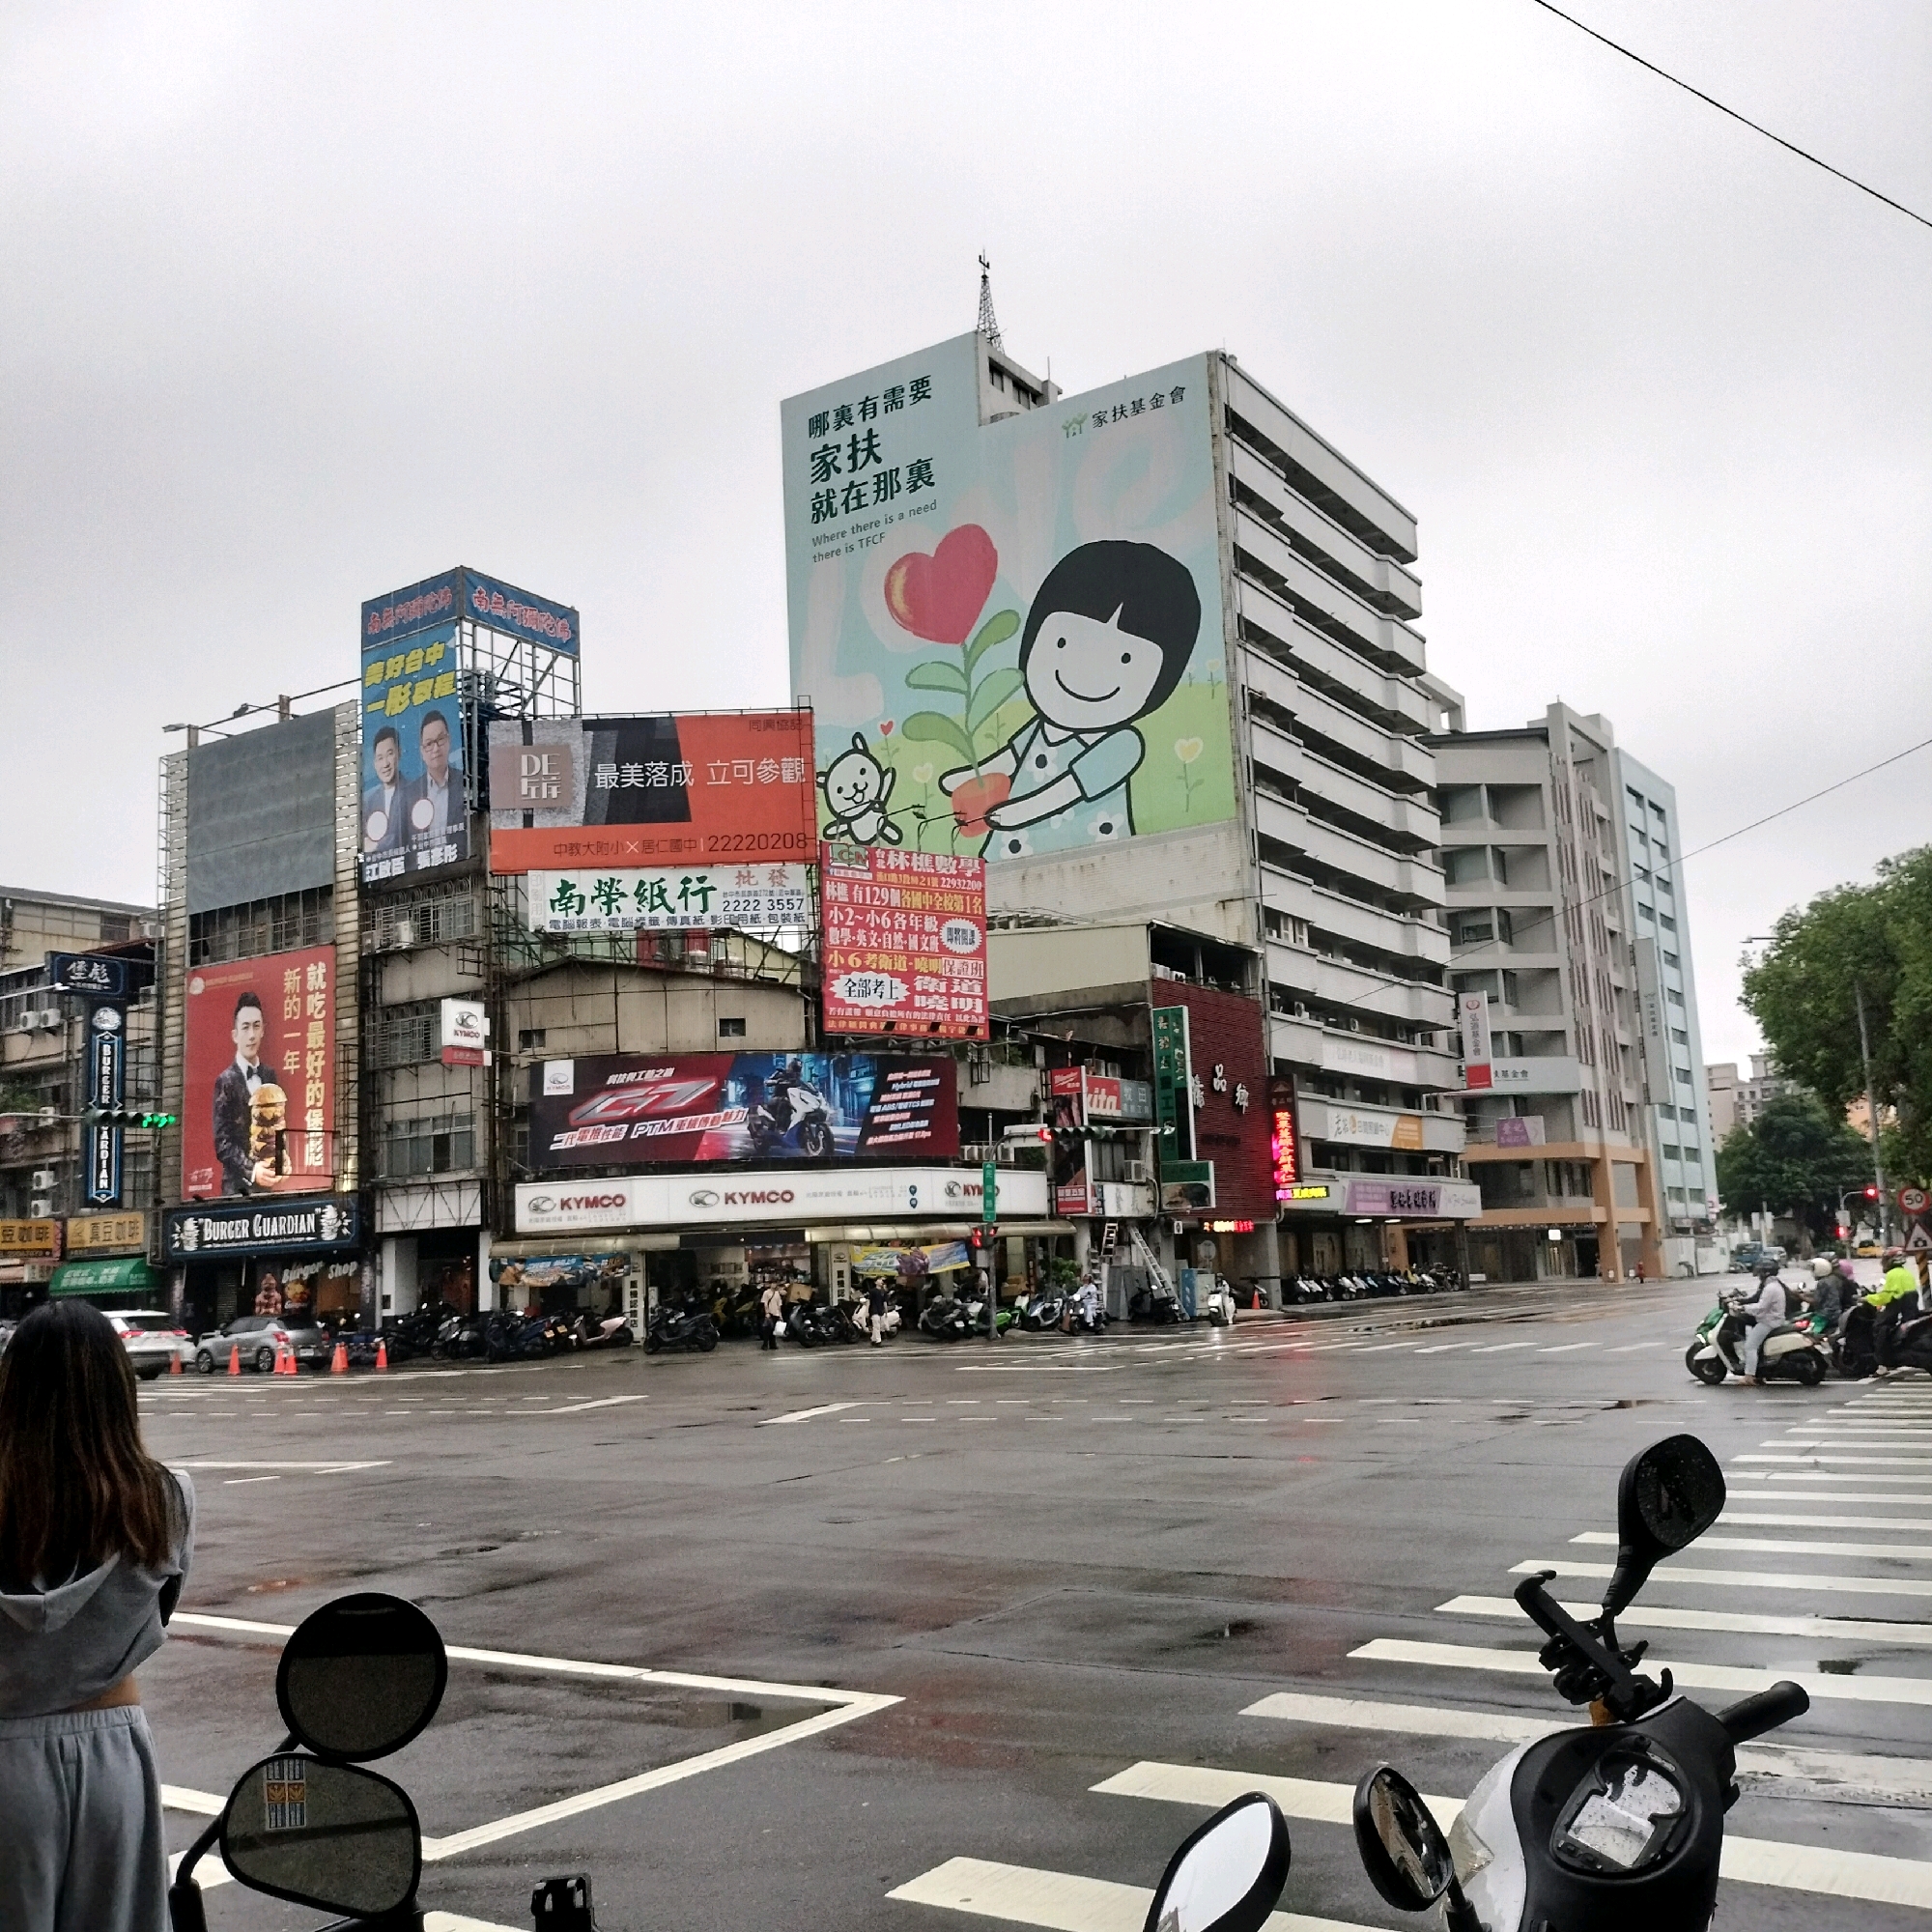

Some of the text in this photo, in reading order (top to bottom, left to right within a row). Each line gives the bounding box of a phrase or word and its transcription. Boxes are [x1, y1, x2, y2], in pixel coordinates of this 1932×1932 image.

[809, 375, 932, 440] 哪裏有需要
[1092, 385, 1187, 429] 家扶基金會
[810, 427, 883, 485] 家扶
[810, 457, 935, 525] 就在那裏
[811, 498, 938, 547] Where there is a need
[812, 532, 886, 563] there is TFCF
[472, 585, 572, 643] 南無阿彌陀佛
[595, 757, 806, 790] 最美落成 立可參觀
[707, 833, 808, 853] 22220208
[735, 869, 789, 888] 批發
[550, 875, 717, 918] 南榮紙行
[723, 898, 804, 912] 2222 3557
[843, 978, 899, 1001] 全部考上
[282, 967, 301, 1075] 新的一年
[560, 1193, 626, 1211] KYMCO
[724, 1189, 795, 1206] KYMCO
[1905, 1193, 1923, 1206] 50
[327, 1260, 358, 1280] Shop
